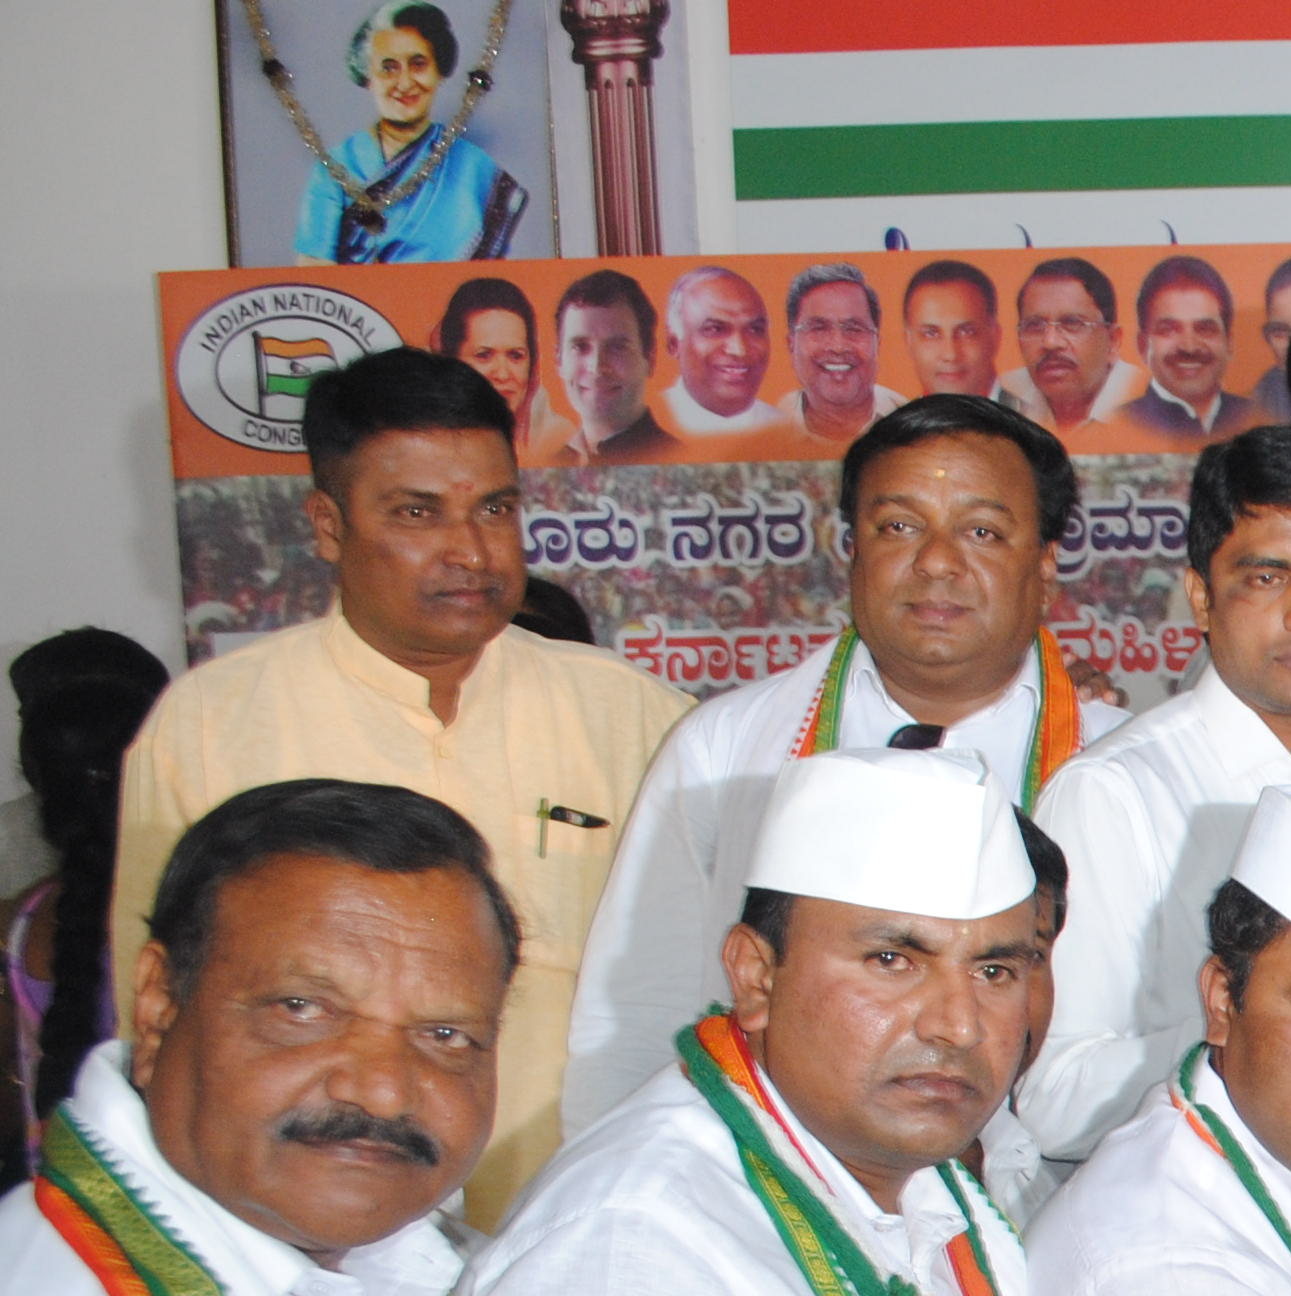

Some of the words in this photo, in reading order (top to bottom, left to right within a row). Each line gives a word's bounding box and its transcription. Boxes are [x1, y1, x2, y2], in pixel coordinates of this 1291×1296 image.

[200, 298, 266, 352] INDIAN
[273, 293, 376, 347] NATIONAL
[243, 419, 304, 447] CONG
[670, 497, 806, 561] ನಗರ
